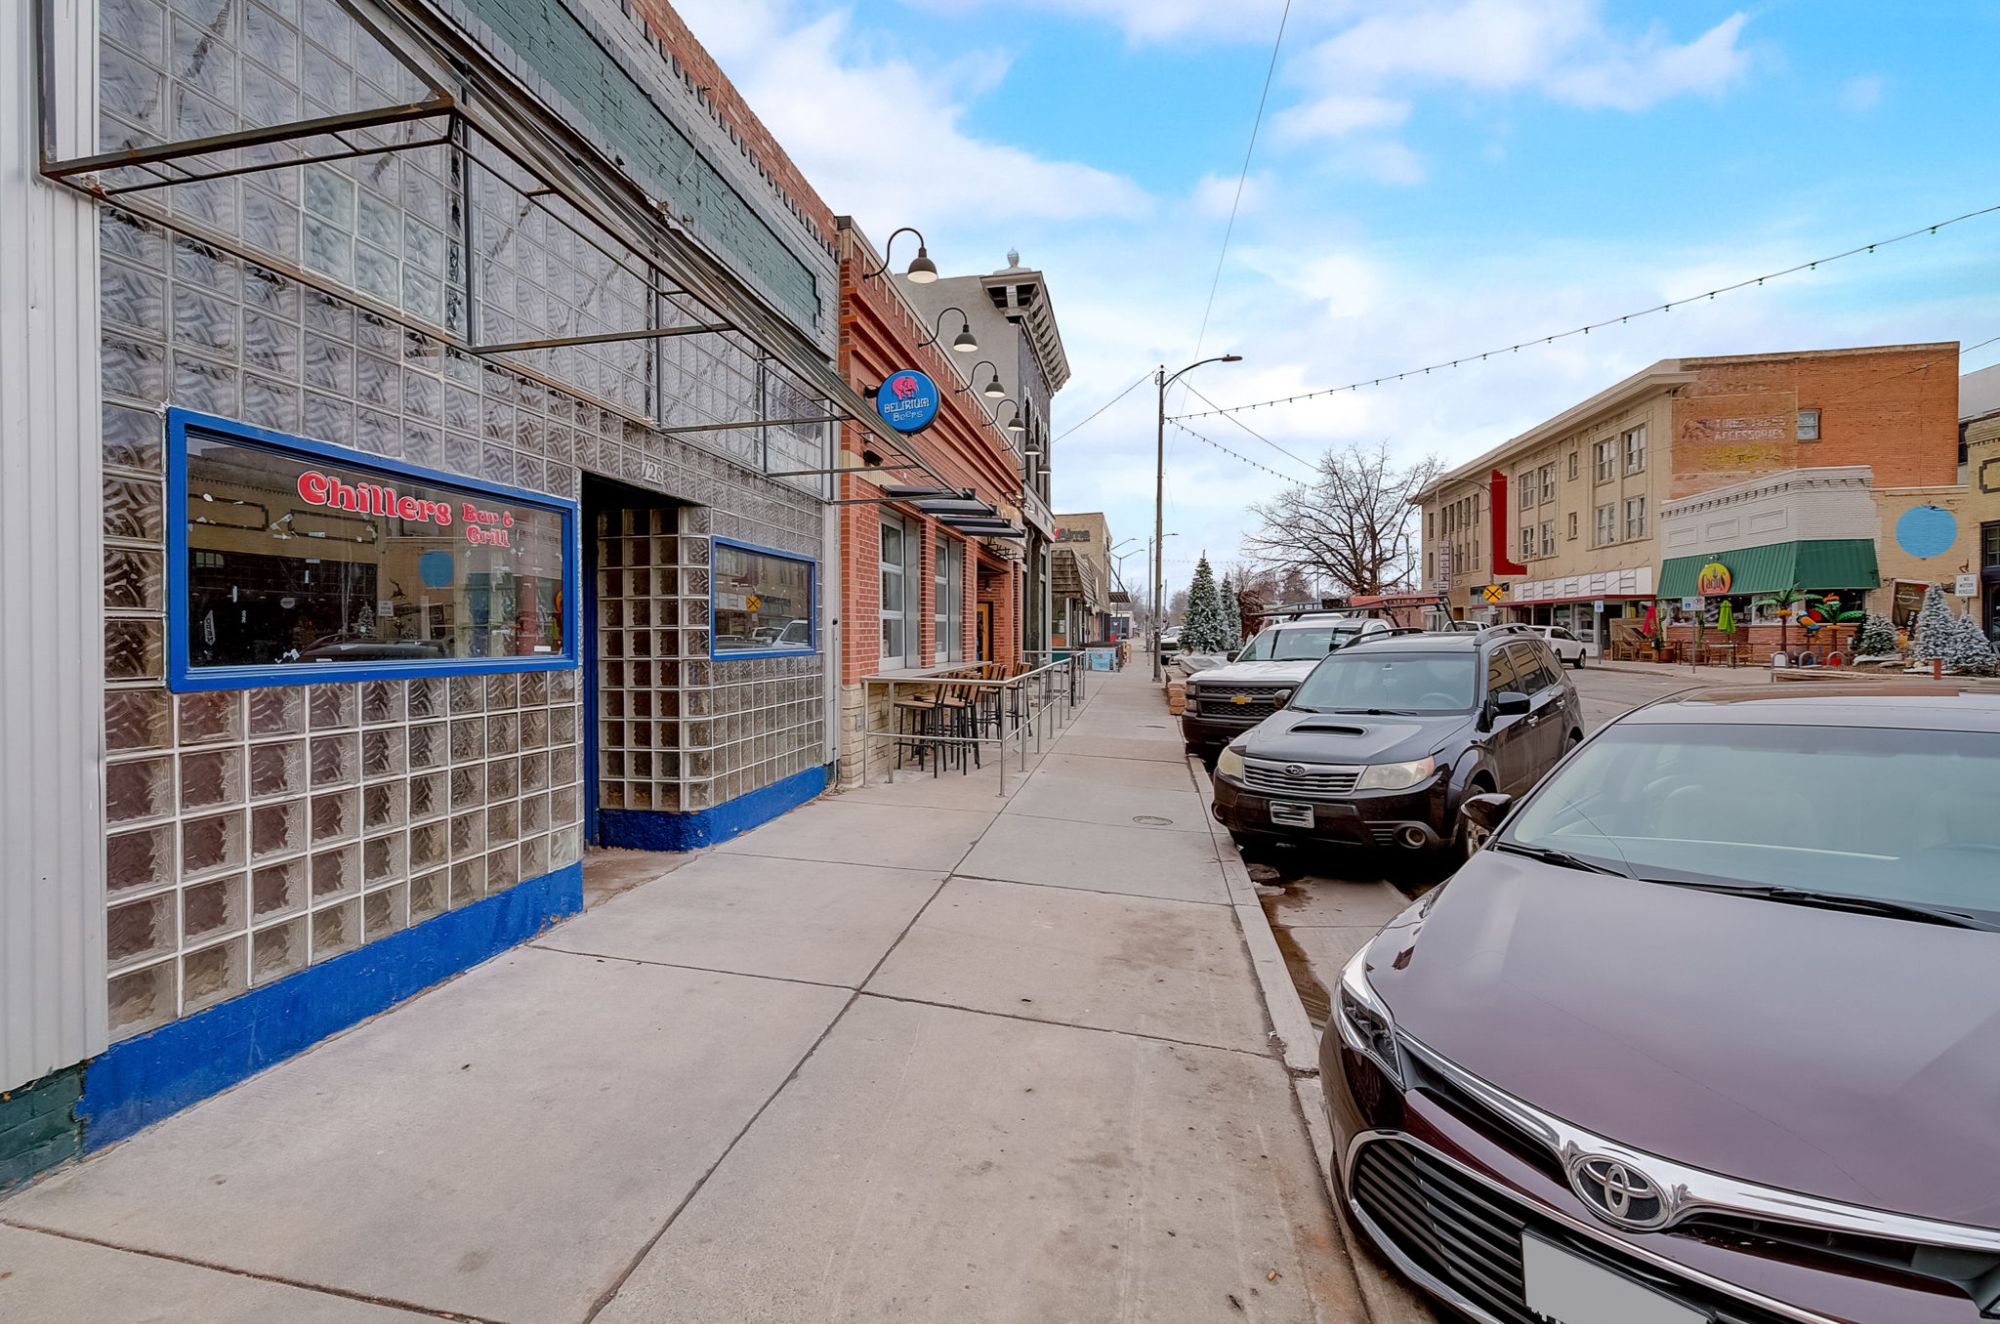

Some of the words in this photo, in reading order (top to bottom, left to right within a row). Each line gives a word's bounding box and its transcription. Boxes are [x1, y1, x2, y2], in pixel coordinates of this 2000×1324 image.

[297, 470, 452, 526] Chillers
[461, 502, 499, 527] Bar
[501, 510, 514, 528] &
[465, 525, 511, 548] Grill
